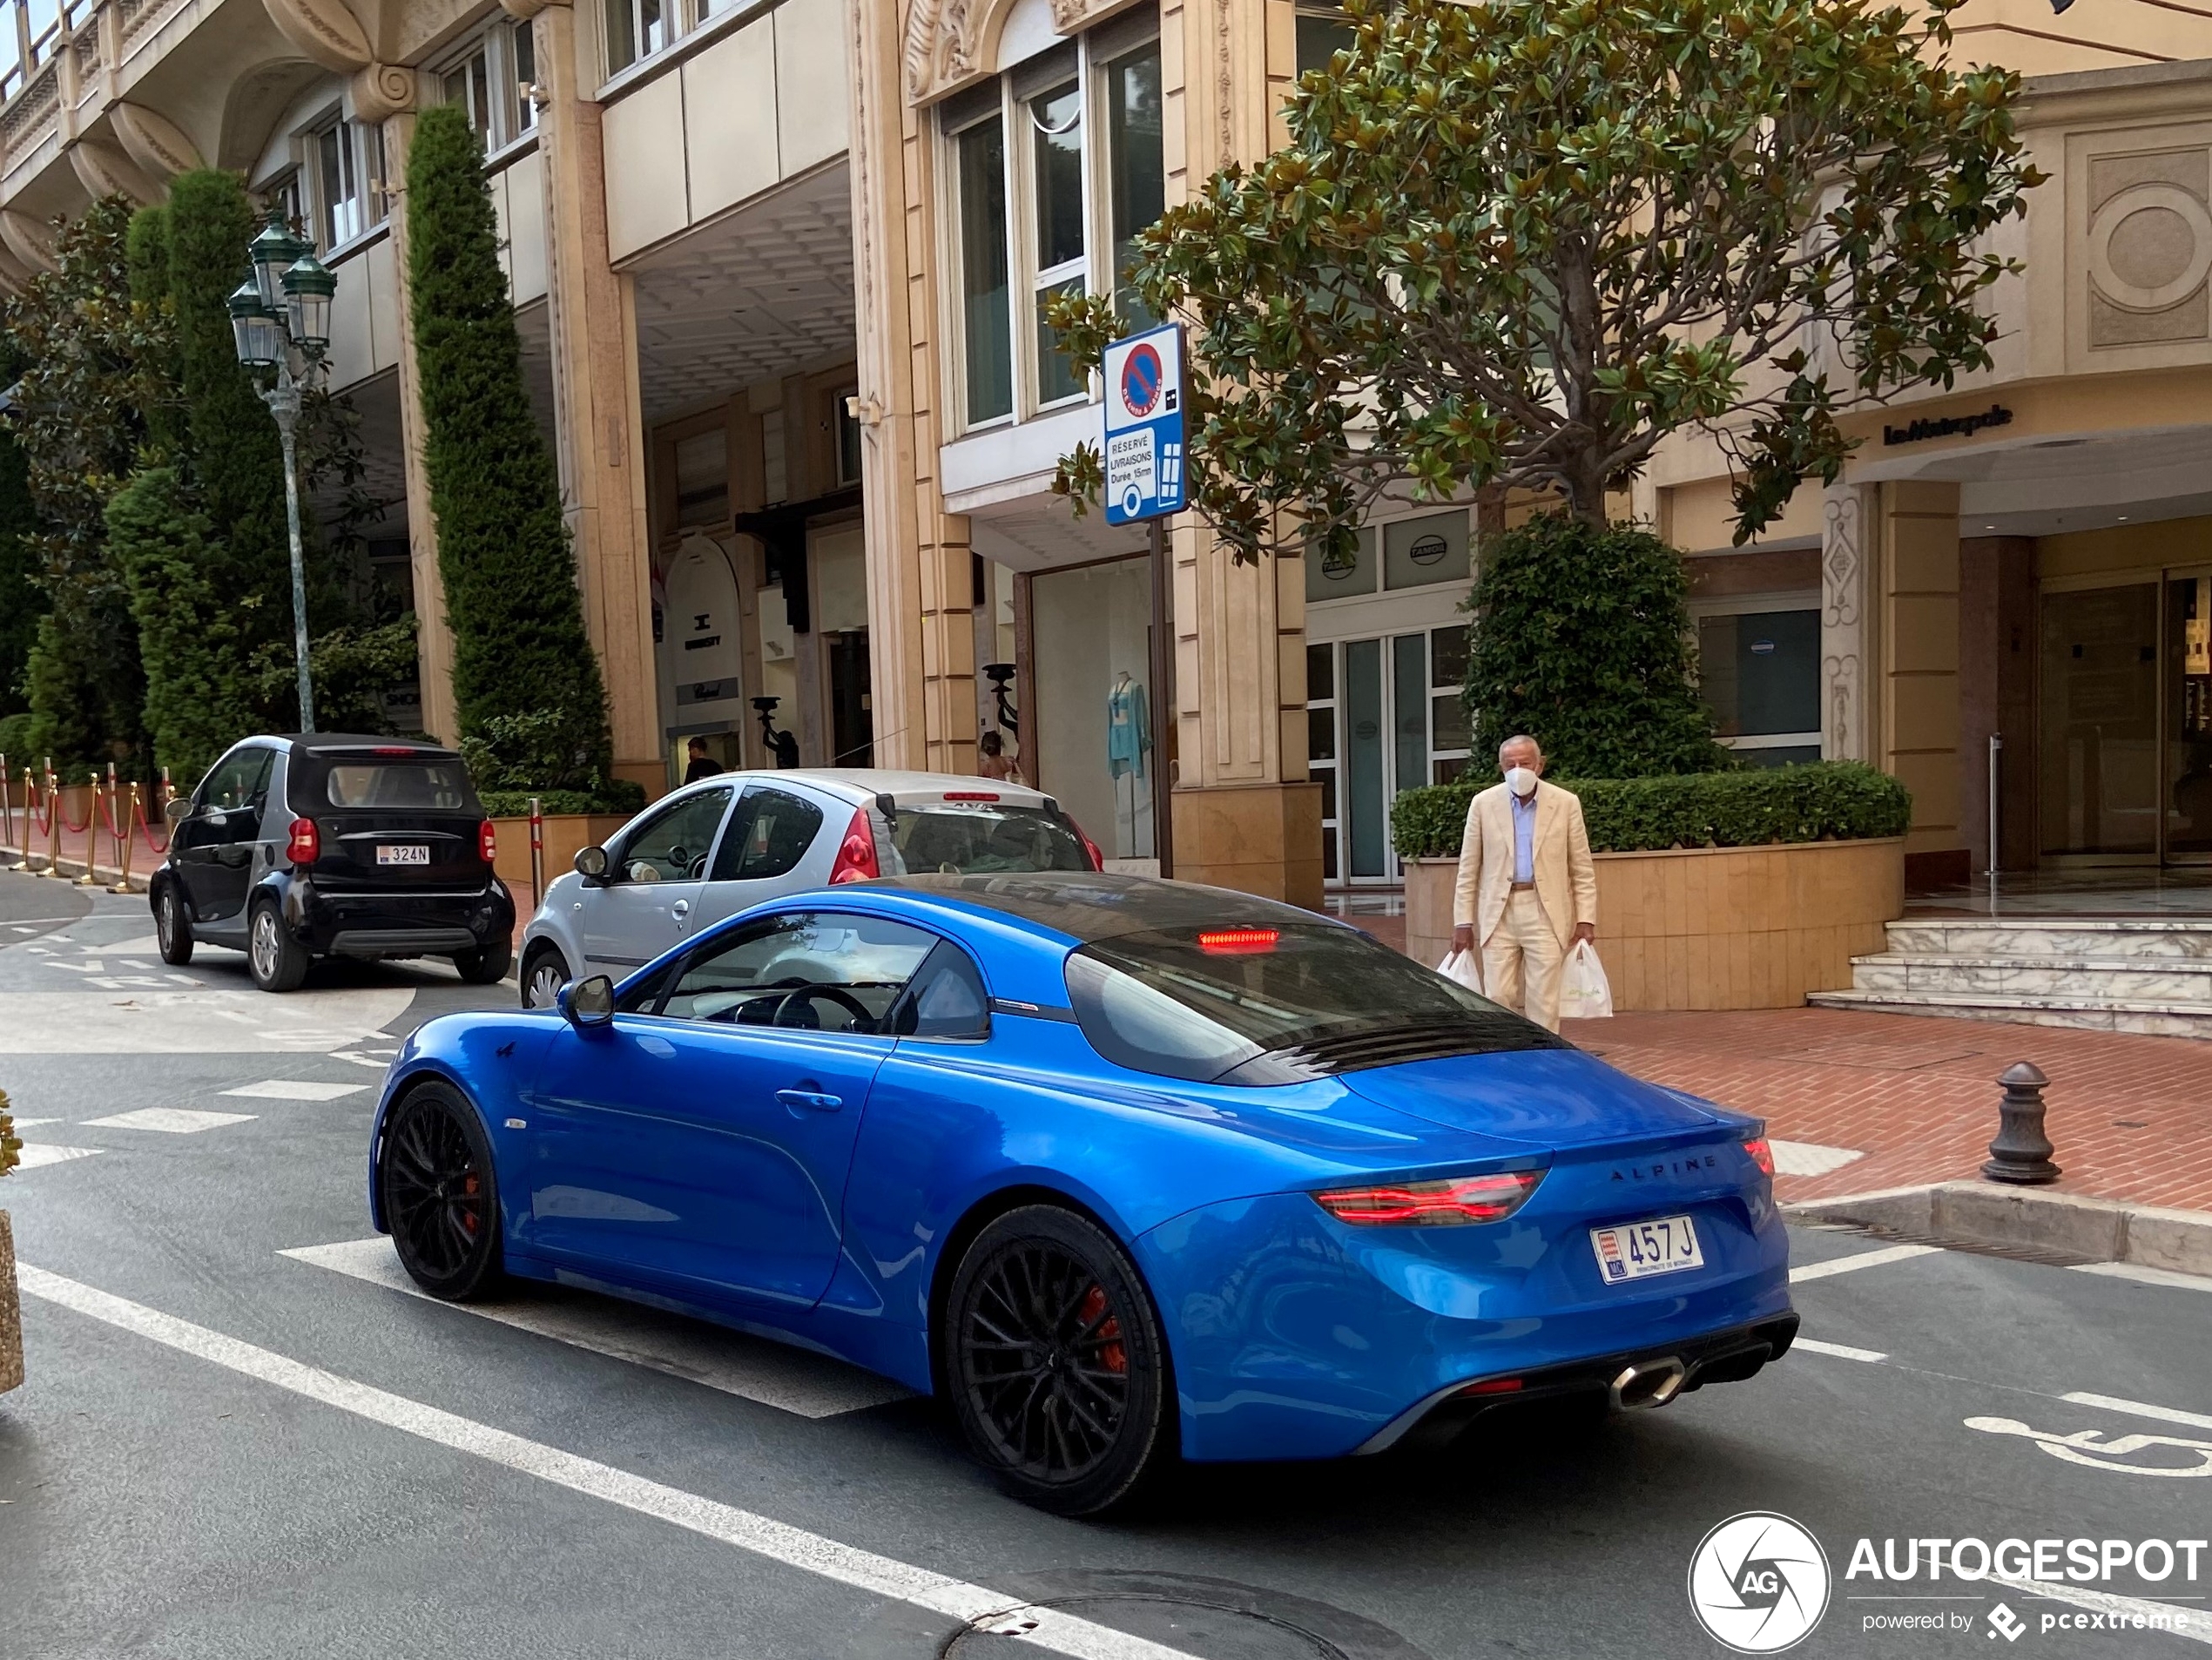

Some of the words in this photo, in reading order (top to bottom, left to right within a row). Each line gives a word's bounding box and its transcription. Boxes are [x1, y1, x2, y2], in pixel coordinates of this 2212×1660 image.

[1111, 435, 1148, 454] RÉSERVÉ
[1110, 450, 1152, 470] LIVRAISONS
[393, 847, 426, 860] 324N
[1611, 1155, 1716, 1181] ALPINE
[1609, 1261, 1623, 1274] MC
